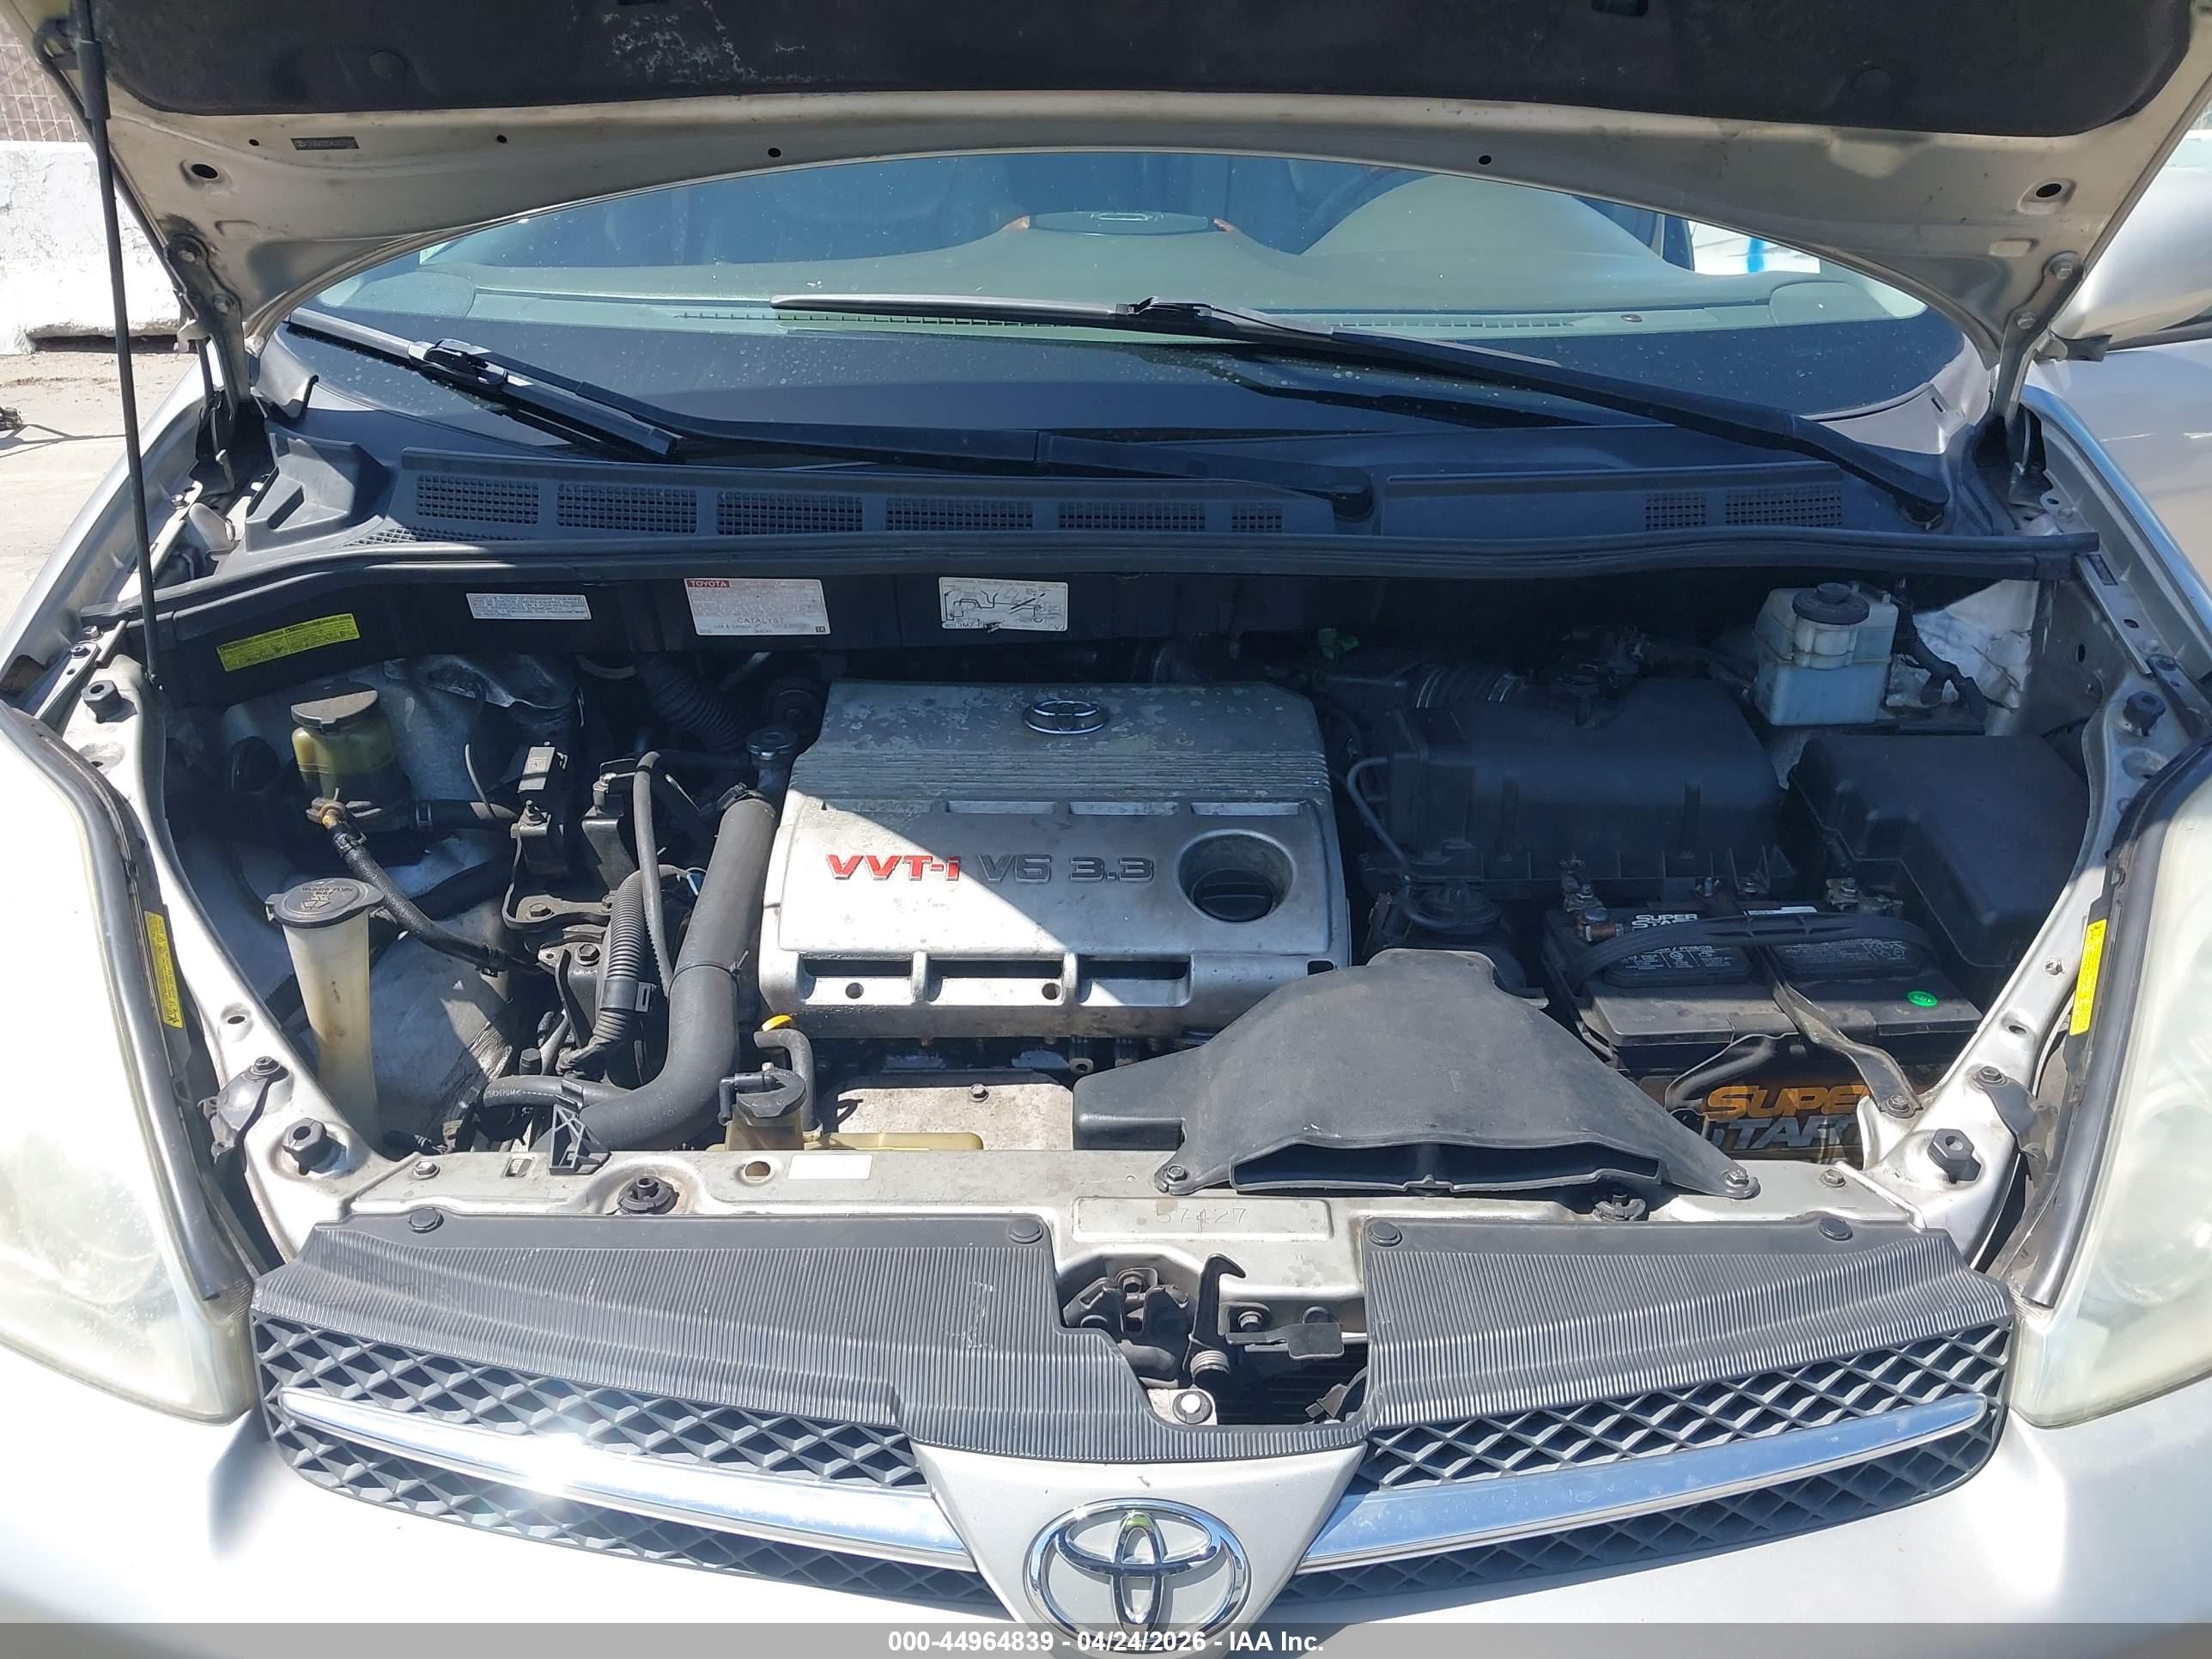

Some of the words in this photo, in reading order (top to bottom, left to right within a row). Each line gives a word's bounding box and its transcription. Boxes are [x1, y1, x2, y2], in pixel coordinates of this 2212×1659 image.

[825, 854, 960, 882] VVT-i
[977, 853, 1052, 884] V6
[1069, 856, 1154, 883] 3.3
[1703, 1085, 1869, 1120] SUPE
